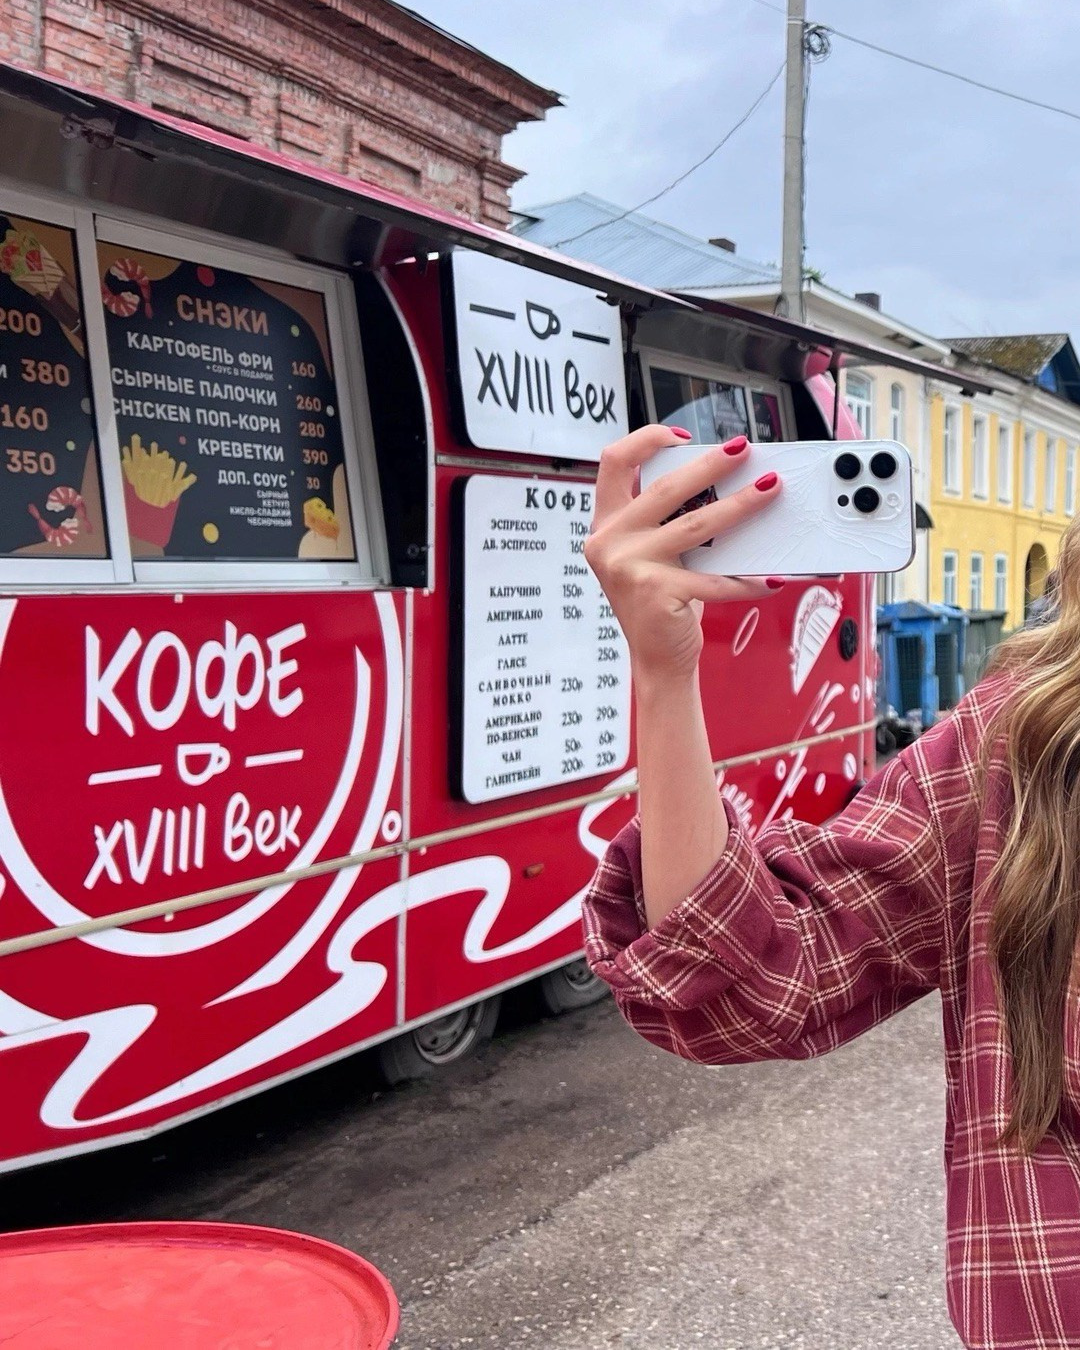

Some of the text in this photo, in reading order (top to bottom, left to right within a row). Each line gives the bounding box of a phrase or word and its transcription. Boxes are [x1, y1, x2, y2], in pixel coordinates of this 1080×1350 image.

[176, 294, 269, 336] СНЭКИ
[127, 331, 273, 372] КАРТОФЕЛЬ ФРИ
[21, 358, 70, 387] 380
[291, 361, 316, 378] 160
[474, 347, 554, 416] XVIII
[111, 367, 322, 412] СЫРНЫЕ ПАЛОЧКИ 260
[1, 404, 48, 432] 160
[113, 397, 325, 438] CHICKEN ПОП-КОРН 280
[6, 449, 56, 476] 350
[198, 438, 328, 466] КРЕВЕТКИ 390
[218, 469, 320, 490] ДОП. СОУС 30
[525, 487, 591, 512] КОФЕ
[491, 518, 538, 532] ЭСПРЕССО
[483, 538, 498, 551] ДВ.
[501, 539, 547, 551] ЭСПРЕССО
[489, 585, 541, 598] КАПУЧИНО
[487, 609, 543, 622] АМЕРИКАНО
[498, 633, 528, 647] ЛАТТЕ
[85, 619, 307, 738] КОФЕ
[478, 671, 551, 693] СЛИВОЧНЫЙ
[493, 691, 532, 707] МОККО
[485, 710, 542, 729] АМЕРИКАНО
[83, 803, 206, 890] XVIII
